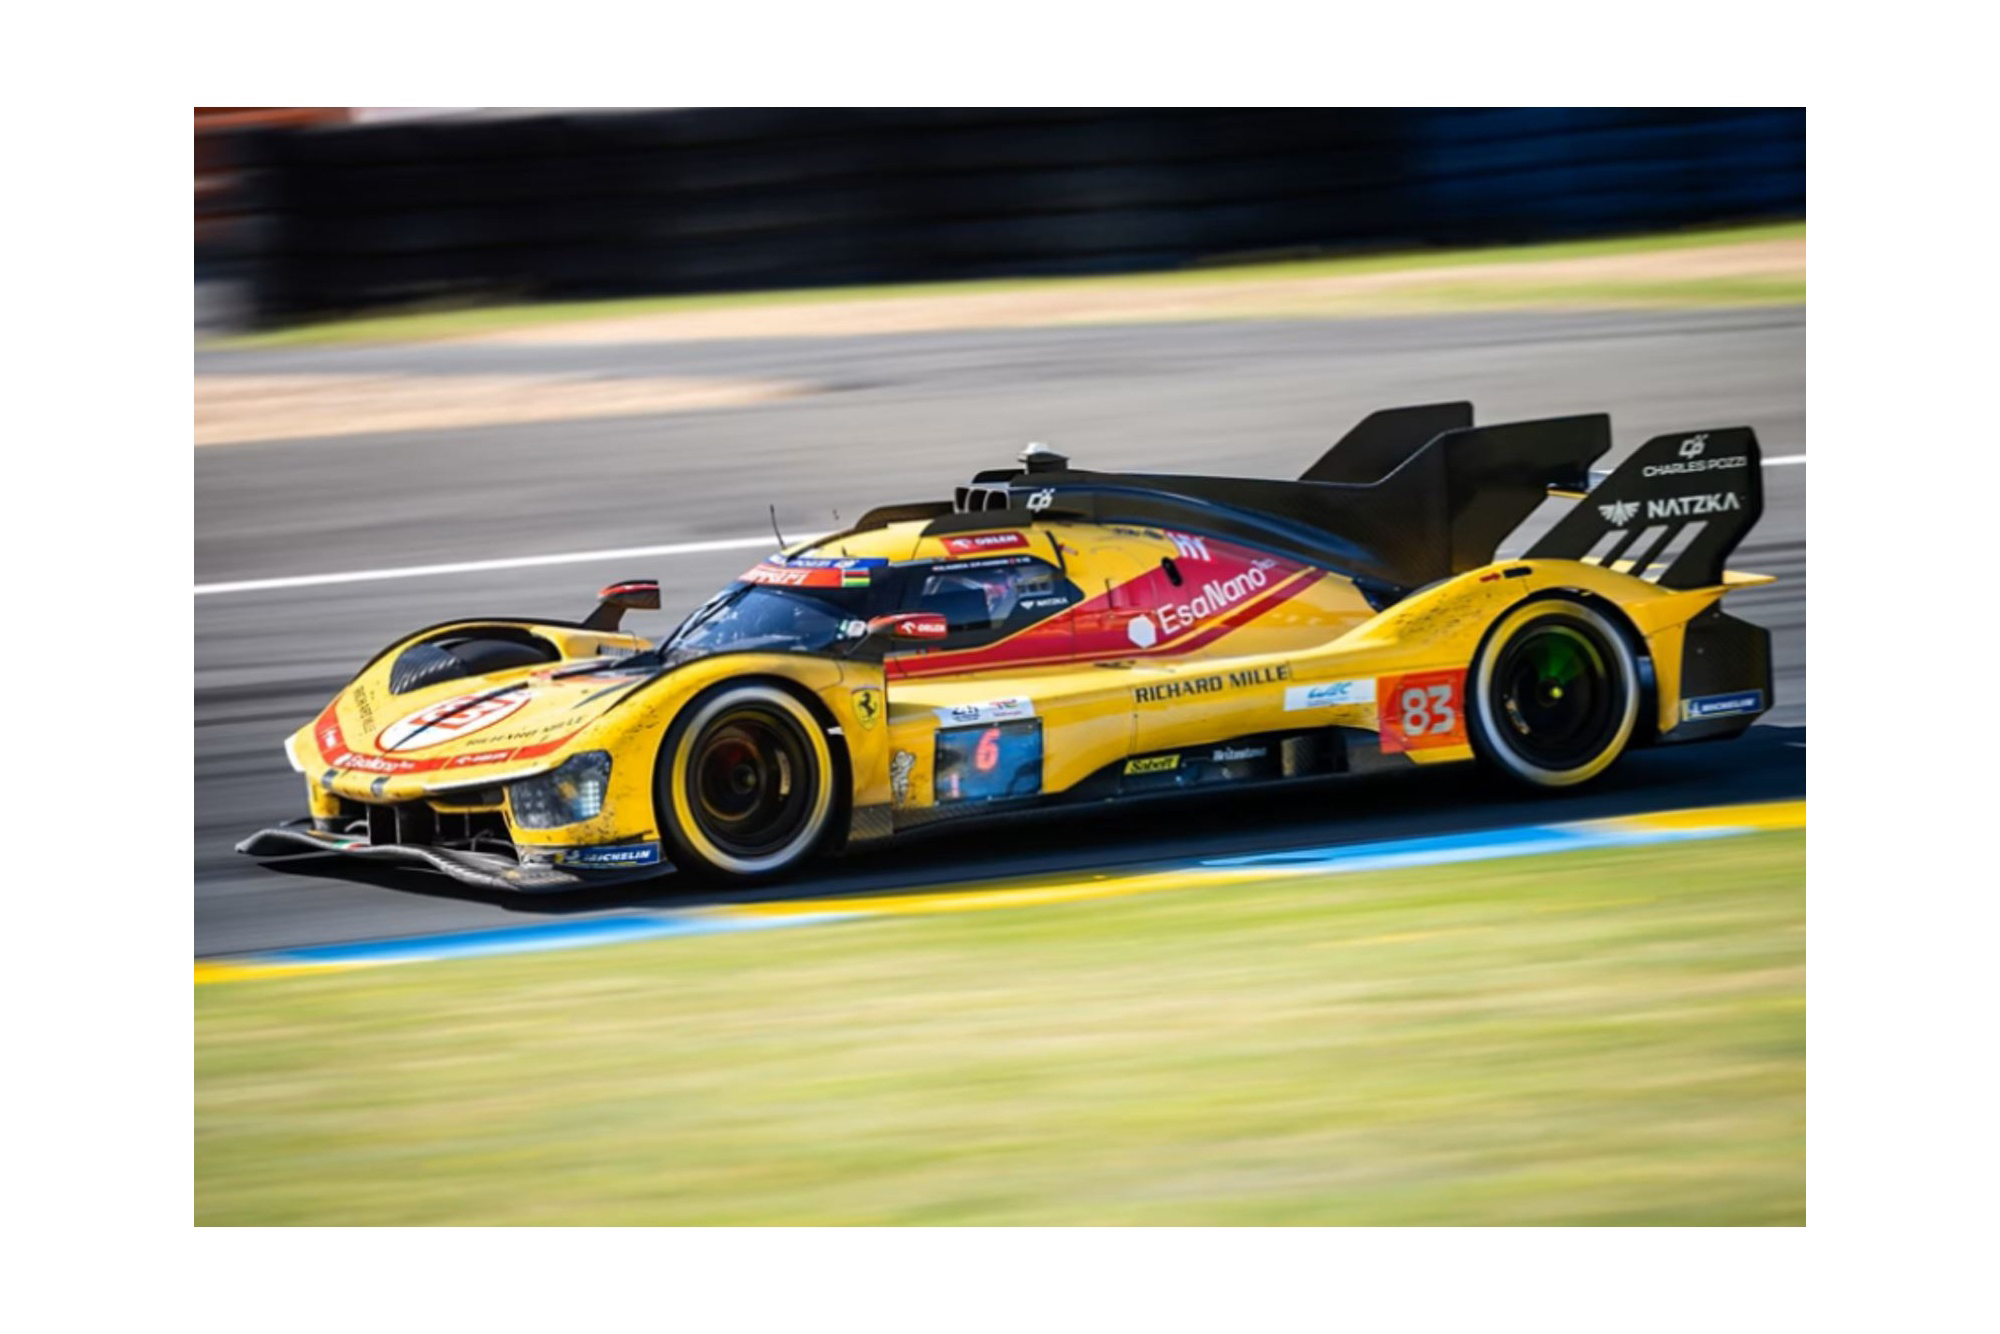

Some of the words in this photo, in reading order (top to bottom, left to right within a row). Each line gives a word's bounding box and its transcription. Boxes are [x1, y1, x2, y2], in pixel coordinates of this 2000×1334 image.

[1642, 459, 1706, 478] CHARLES
[1707, 455, 1748, 471] POZZI
[1647, 491, 1741, 519] NATZKA
[1155, 566, 1267, 636] EsaNano
[1133, 676, 1223, 704] RICHARD
[1228, 664, 1288, 688] MILLE
[1401, 684, 1455, 736] 83
[974, 726, 1001, 773] 6
